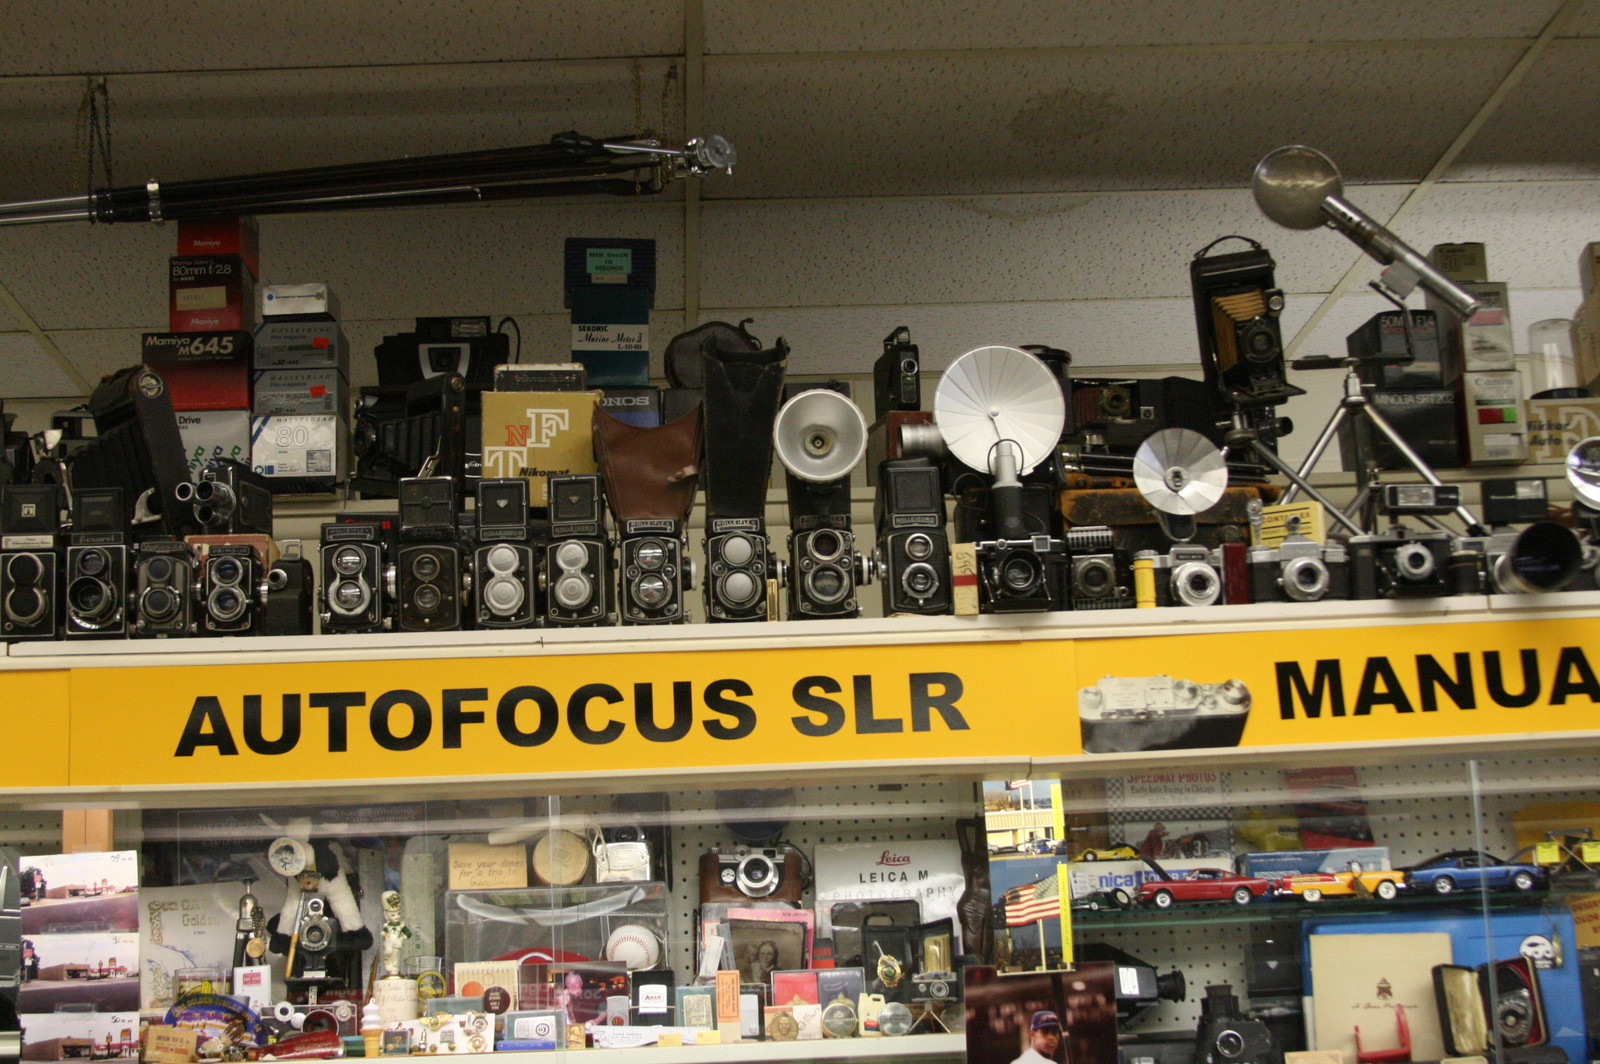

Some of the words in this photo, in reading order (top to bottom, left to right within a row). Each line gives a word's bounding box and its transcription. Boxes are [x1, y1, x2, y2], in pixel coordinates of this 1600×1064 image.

[172, 265, 206, 277] 80mm
[191, 318, 219, 326] Mamiya
[145, 335, 191, 349] Mamiya
[578, 332, 610, 343] Marine
[610, 332, 635, 343] Meter
[1374, 393, 1415, 405] MINOLTA
[178, 415, 202, 425] Drive
[275, 425, 309, 448] 80
[1529, 434, 1562, 447] Auto
[518, 467, 571, 477] Nikomat
[716, 519, 758, 527] ROLLEIFLEX
[174, 678, 757, 757] AUTOFOCUS
[790, 671, 970, 737] SLR
[875, 850, 912, 866] Leica
[453, 860, 473, 869] Save
[476, 861, 498, 871] your
[499, 859, 525, 868] dimes
[459, 869, 473, 880] for
[477, 869, 484, 877] a
[488, 868, 504, 877] trip
[859, 871, 909, 884] LEICA
[918, 869, 929, 881] M
[832, 886, 958, 900] PHOTOGRAPHY
